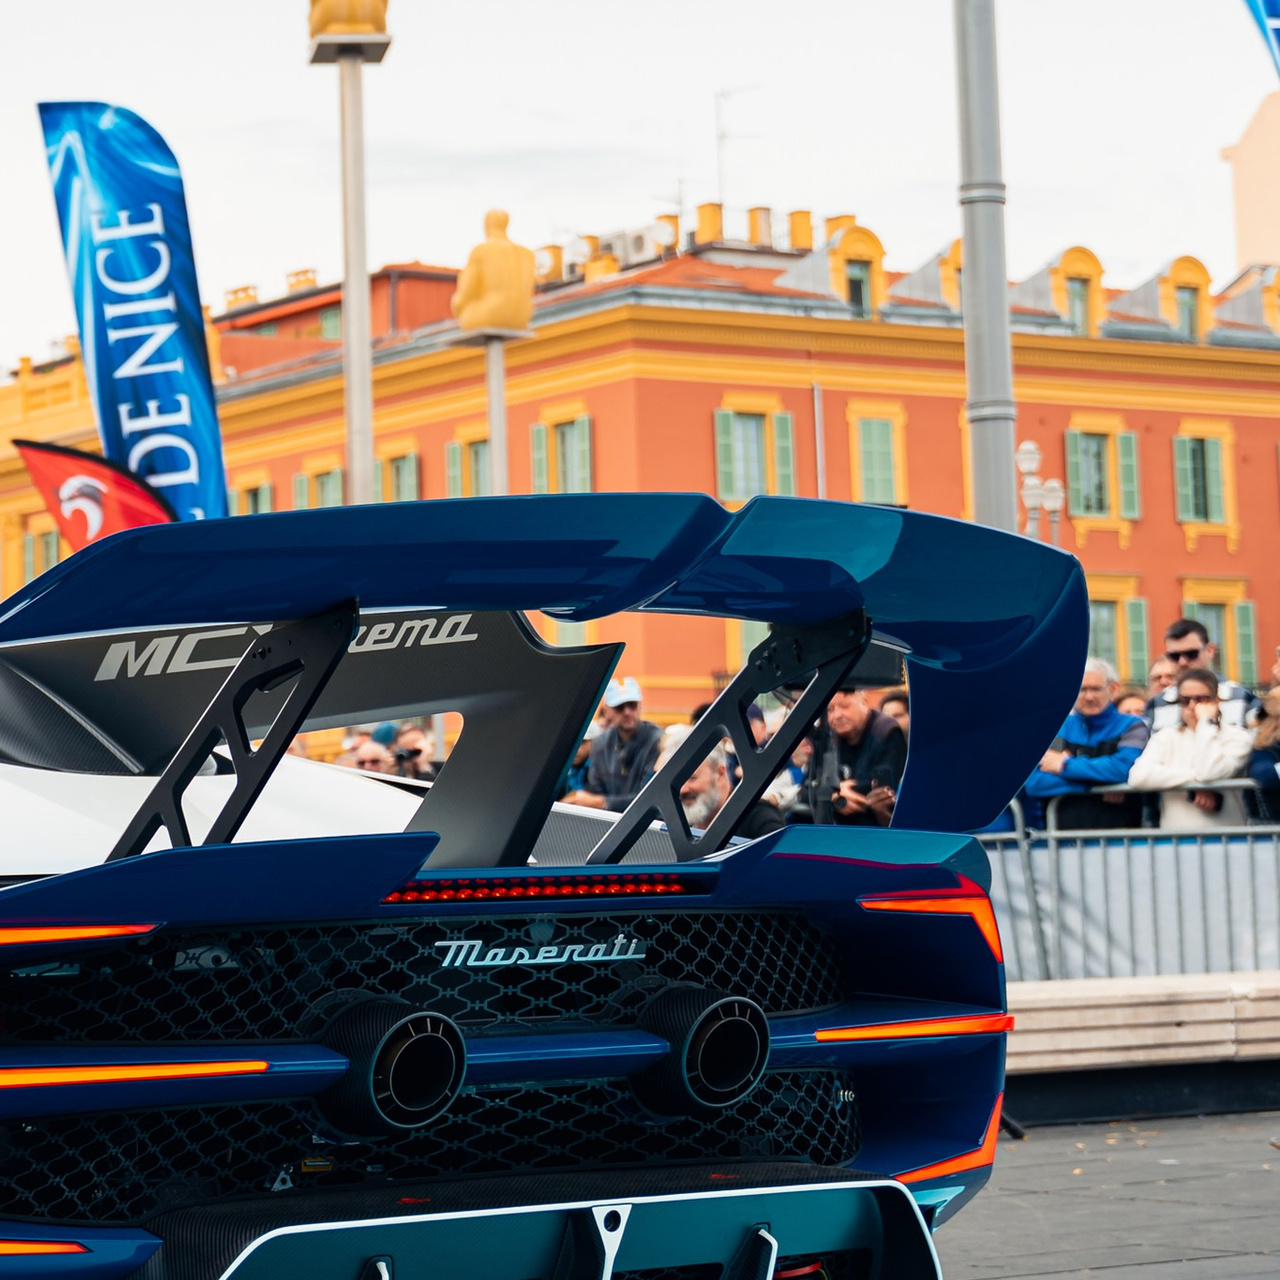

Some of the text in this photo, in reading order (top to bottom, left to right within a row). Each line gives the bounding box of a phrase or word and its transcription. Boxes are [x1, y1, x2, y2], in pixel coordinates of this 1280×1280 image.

[87, 201, 200, 489] DE NICE
[434, 933, 646, 967] Maserati
